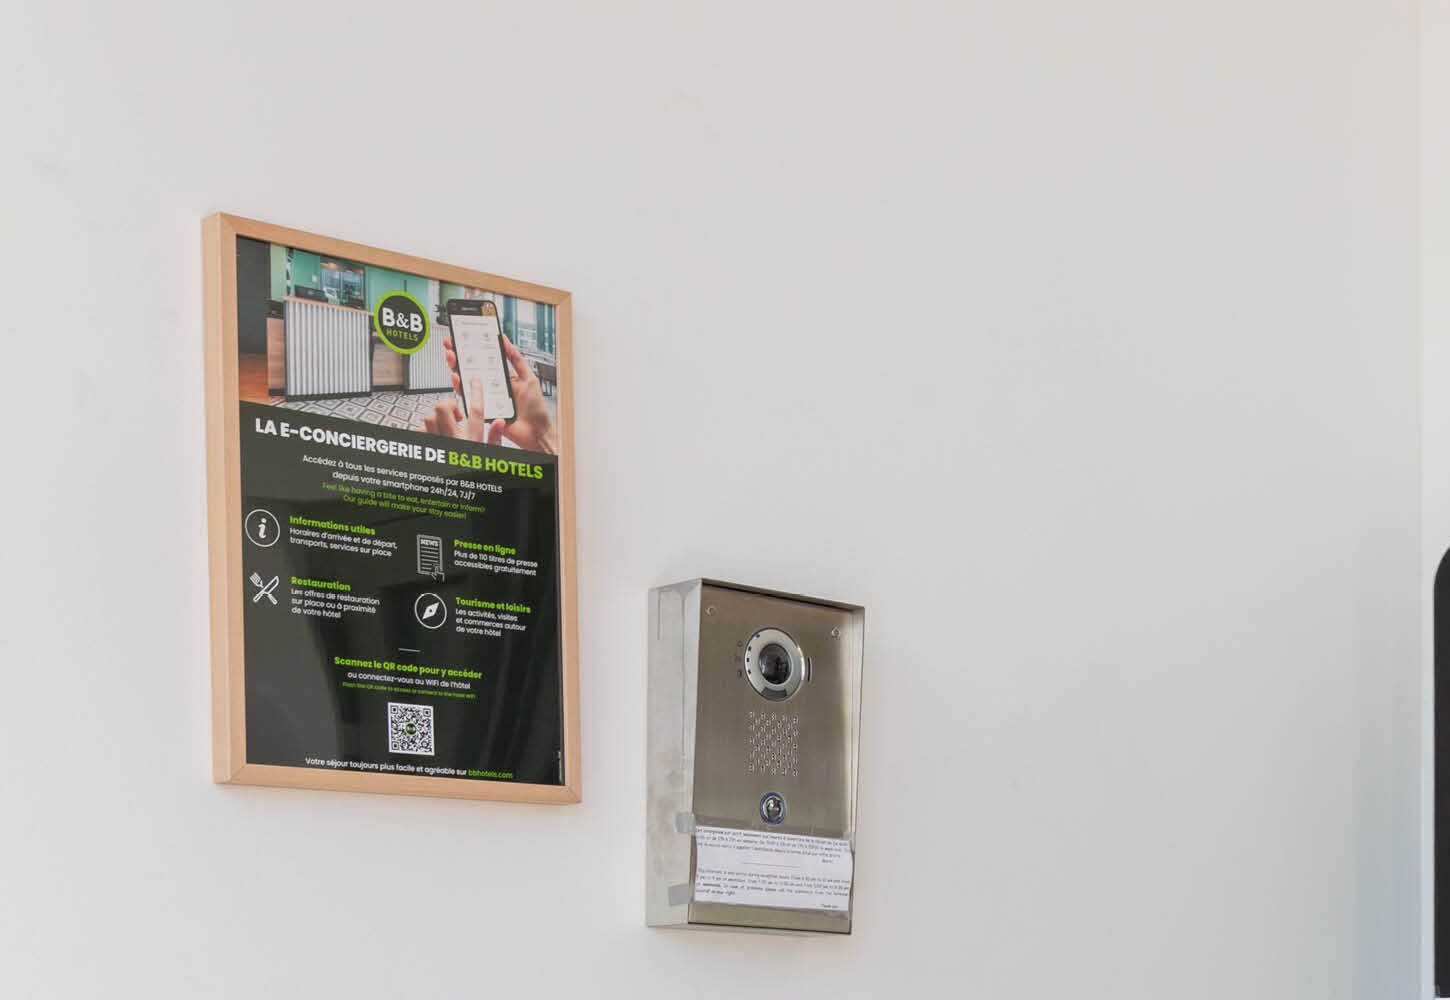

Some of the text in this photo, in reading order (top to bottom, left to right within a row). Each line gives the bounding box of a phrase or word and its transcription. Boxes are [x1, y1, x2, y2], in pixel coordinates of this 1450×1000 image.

[382, 307, 423, 332] B&B
[386, 328, 418, 341] HOTELS
[255, 418, 543, 480] LA E-CONCIERGERIE DE B&B HOTELS
[303, 455, 337, 467] Accédez
[345, 461, 362, 471] tous
[364, 463, 375, 473] les
[377, 466, 408, 478] services
[410, 472, 444, 484] proposés
[446, 478, 459, 487] par
[460, 480, 475, 489] B&B
[476, 483, 503, 493] HOTELS
[332, 471, 359, 482] depuis
[361, 475, 380, 485] votre
[383, 479, 429, 493] smartphone
[289, 515, 376, 535] Informations utiles
[290, 527, 320, 538] Horaires
[353, 536, 361, 544] et
[362, 537, 371, 545] de
[330, 541, 359, 553] services
[360, 545, 371, 553] sur
[372, 546, 392, 557] place
[454, 539, 516, 556] Presse en ligne
[454, 550, 468, 559] Plus
[469, 551, 478, 559] de
[488, 554, 505, 563] titres
[506, 556, 515, 564] de
[516, 558, 538, 569] presse
[454, 560, 537, 576] accessibles gratuitement
[291, 576, 351, 592] Restauration
[291, 588, 380, 606] Les offres de restauration
[455, 597, 531, 613] Tourisme et loisirs
[291, 606, 301, 614] de
[303, 607, 322, 617] votre
[304, 598, 325, 609] place
[326, 601, 336, 609] ou
[343, 601, 376, 614] proximité
[455, 608, 466, 616] Les
[497, 612, 518, 622] visites
[456, 625, 466, 633] de
[466, 627, 483, 636] votre
[464, 619, 503, 629] commerces
[504, 623, 526, 632] autour
[334, 656, 482, 679] Scannez le QR code pour y accéder
[358, 672, 414, 685] connectez-vous
[415, 678, 425, 686] au
[441, 680, 449, 688] de
[305, 757, 326, 766] Votre
[326, 758, 349, 769] séjour
[350, 760, 378, 771] toujours
[380, 763, 395, 773] plus
[396, 763, 415, 773] facile
[425, 766, 455, 777] agréable
[456, 768, 467, 776] sur
